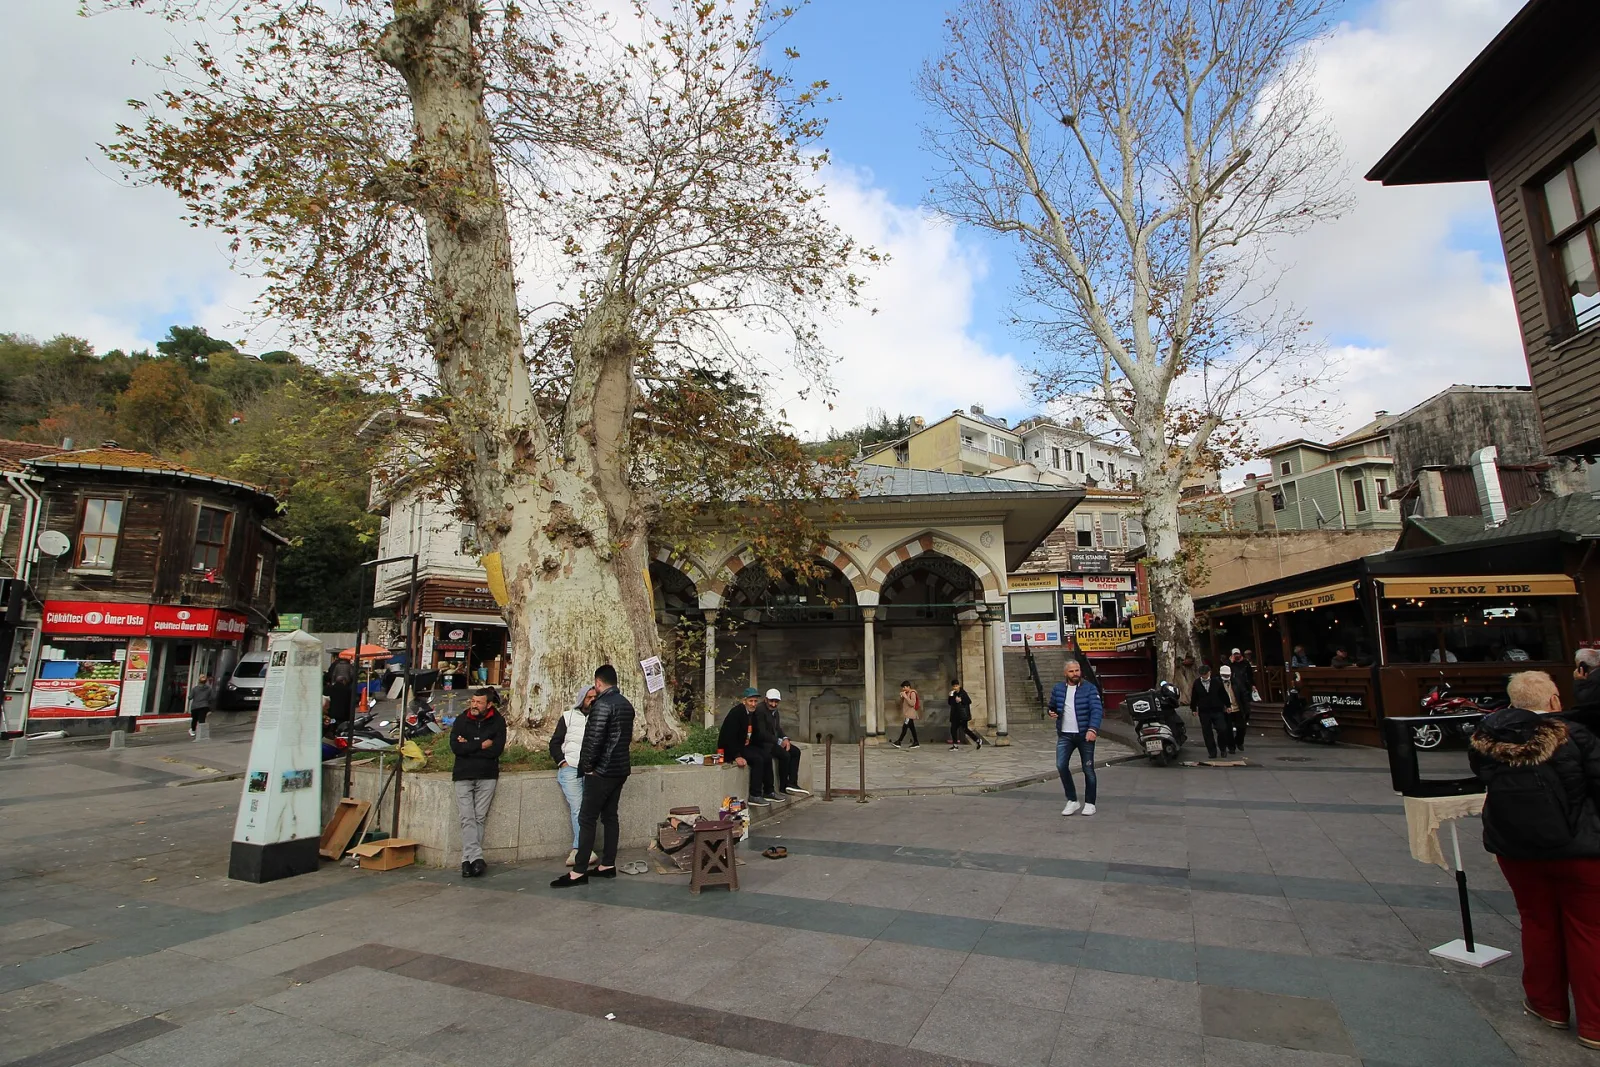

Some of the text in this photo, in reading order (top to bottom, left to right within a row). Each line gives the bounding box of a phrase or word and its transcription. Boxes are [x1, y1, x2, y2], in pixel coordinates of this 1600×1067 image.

[1429, 584, 1531, 594] BEYKOZ PİDE
[1288, 598, 1313, 609] BEYKOZ
[46, 612, 144, 625] Çiğköfteci Ömer Usta
[180, 620, 196, 631] Ömer
[196, 623, 209, 631] Usta
[1078, 629, 1129, 638] KIRTASİYE
